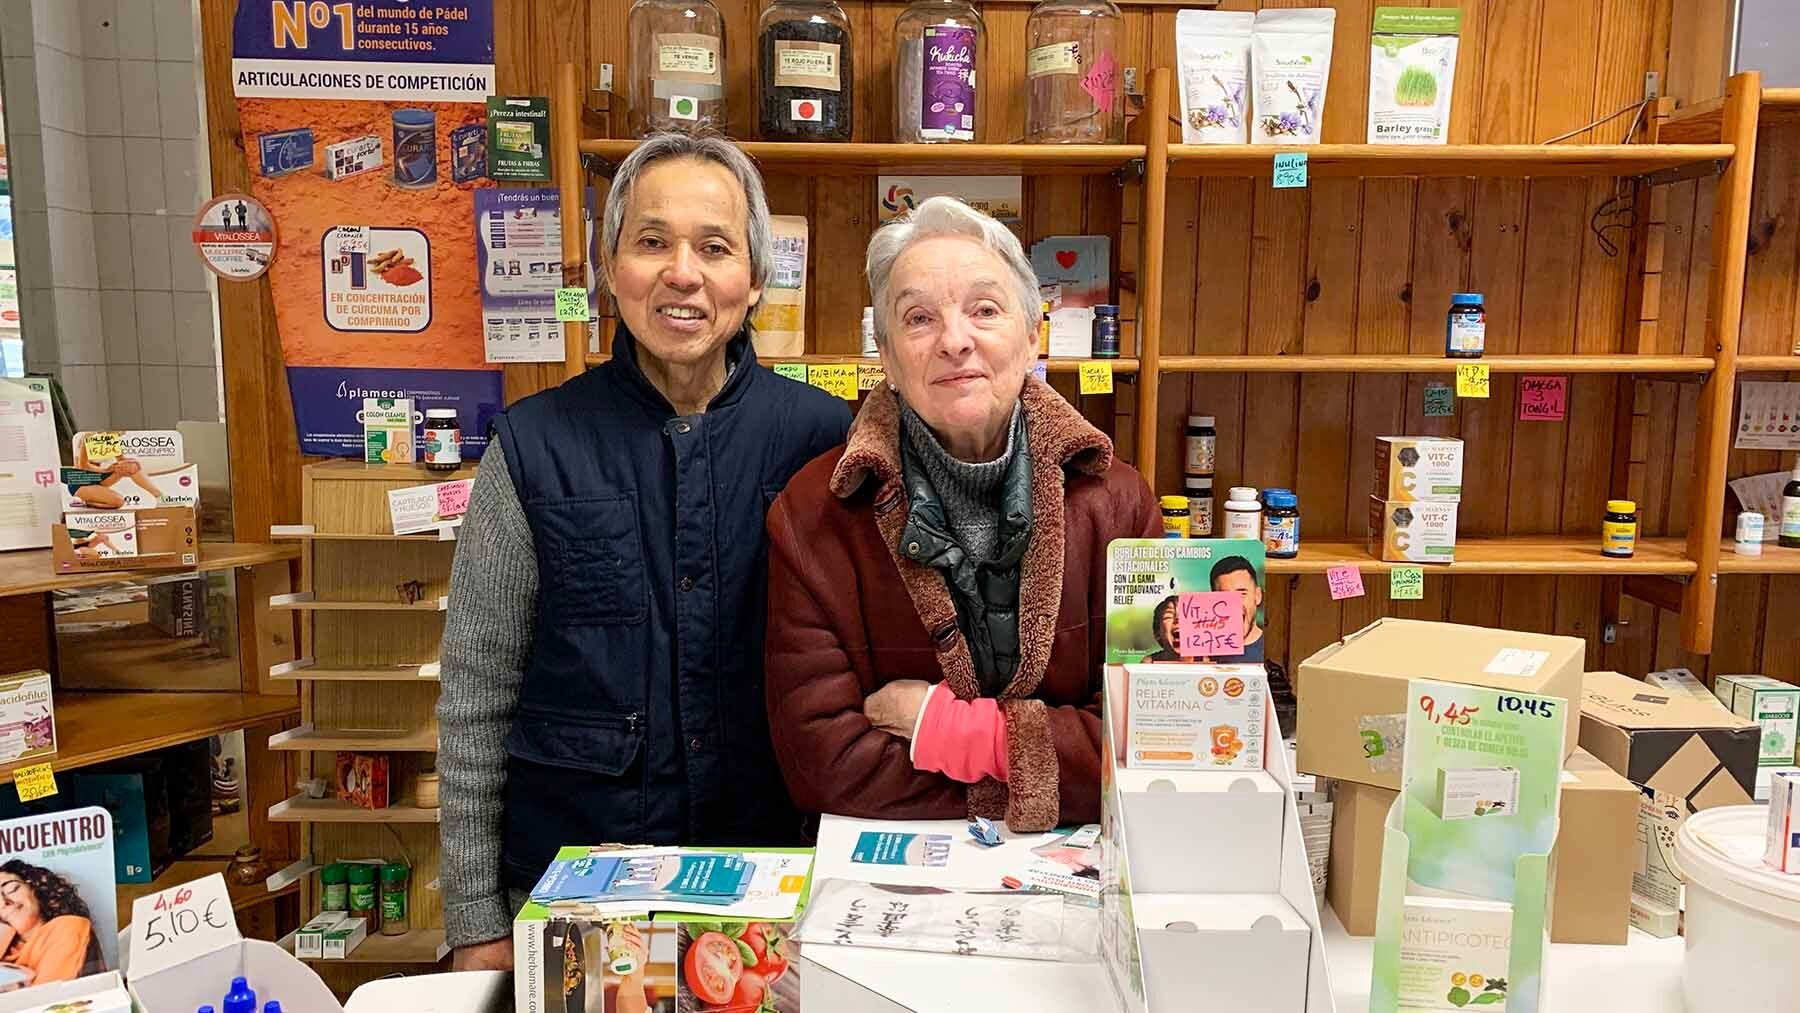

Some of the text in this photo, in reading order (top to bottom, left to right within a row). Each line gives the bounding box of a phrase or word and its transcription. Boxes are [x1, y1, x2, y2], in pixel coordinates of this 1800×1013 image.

[357, 6, 468, 21] del mundo de Pádel
[357, 22, 449, 36] durante 15 años
[358, 38, 436, 50] consecutivos.
[238, 71, 487, 91] ARTICULACIONES DE COMPETICIÓN
[1376, 124, 1412, 134] Barley
[331, 292, 426, 305] EN CONCENTRACIÓN
[336, 305, 349, 314] DE
[401, 306, 421, 316] POR
[347, 316, 411, 327] COMPRIMIDO
[1521, 379, 1562, 391] OMEGA
[349, 387, 404, 400] plameca
[1534, 391, 1545, 401] 3
[119, 437, 175, 448] ALOSSEA
[1427, 453, 1455, 461] VIT-C
[1421, 513, 1448, 522] VIT-C
[1150, 547, 1160, 559] DE
[1160, 547, 1176, 559] LOS
[1176, 547, 1212, 559] CAMBIOS
[1113, 560, 1169, 573] ESTACIONALES
[1113, 575, 1156, 584] CON LA GAMA
[1113, 596, 1134, 605] RELIEF
[1211, 600, 1230, 619] C
[1135, 688, 1175, 699] RELIEF
[1136, 700, 1215, 712] VITAMINA C
[1419, 695, 1479, 726] 9,45
[153, 888, 193, 912] 4,60
